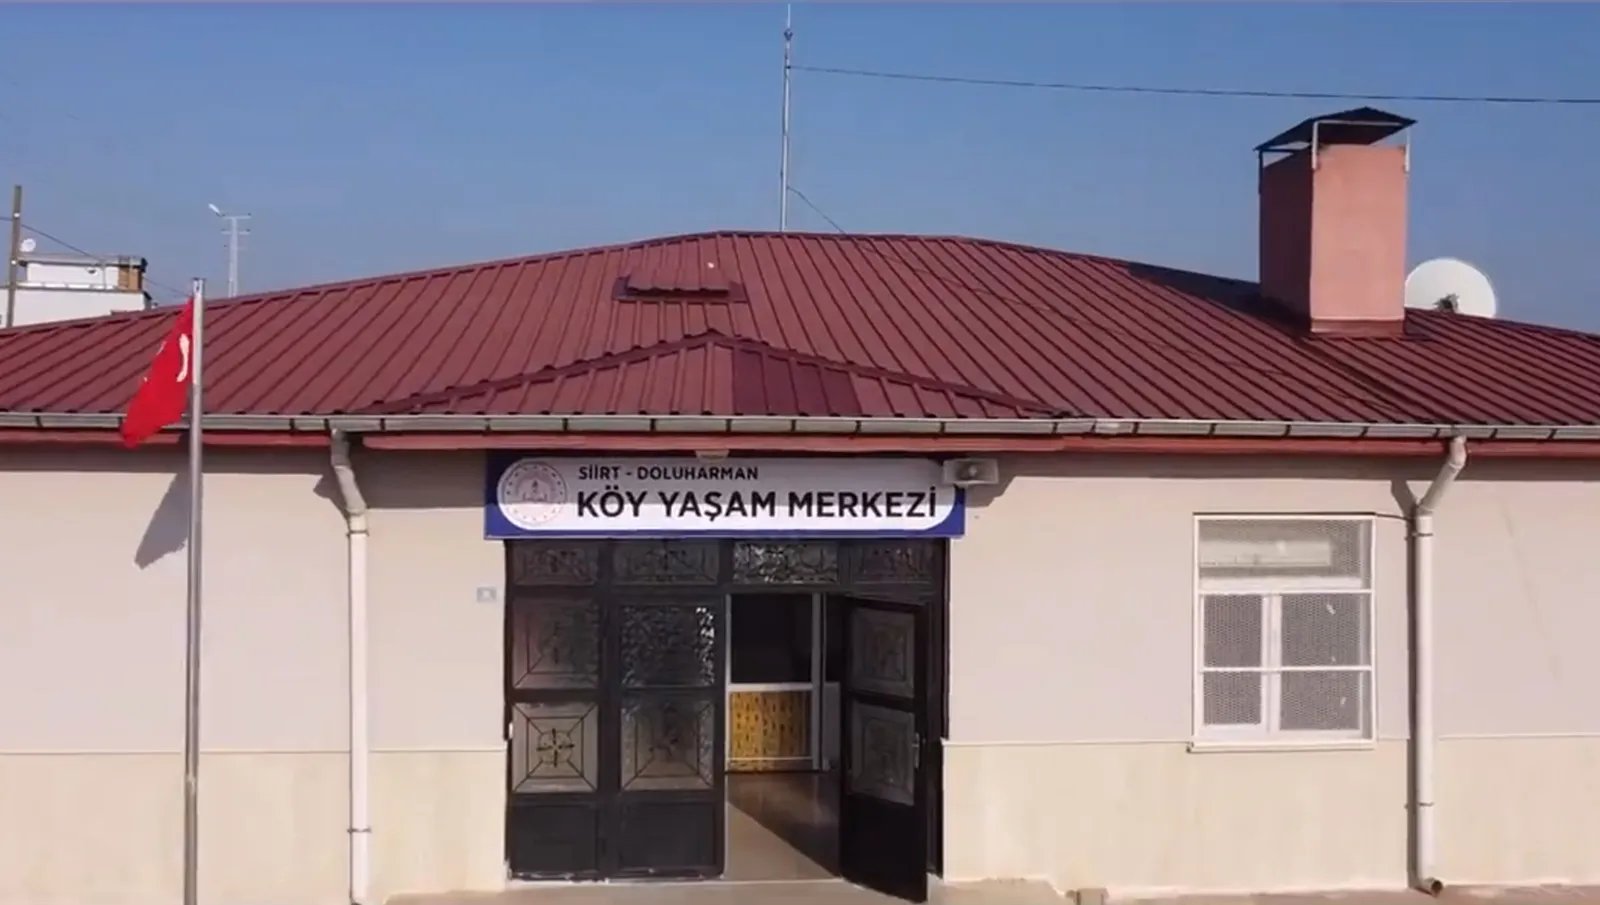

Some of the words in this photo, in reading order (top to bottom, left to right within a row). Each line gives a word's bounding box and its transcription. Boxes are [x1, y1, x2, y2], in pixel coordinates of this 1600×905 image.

[637, 466, 758, 480] DOLUHARMAN
[577, 484, 647, 517] KÖY
[658, 491, 776, 521] YAŞAM
[788, 486, 936, 517] MERKEZİ
